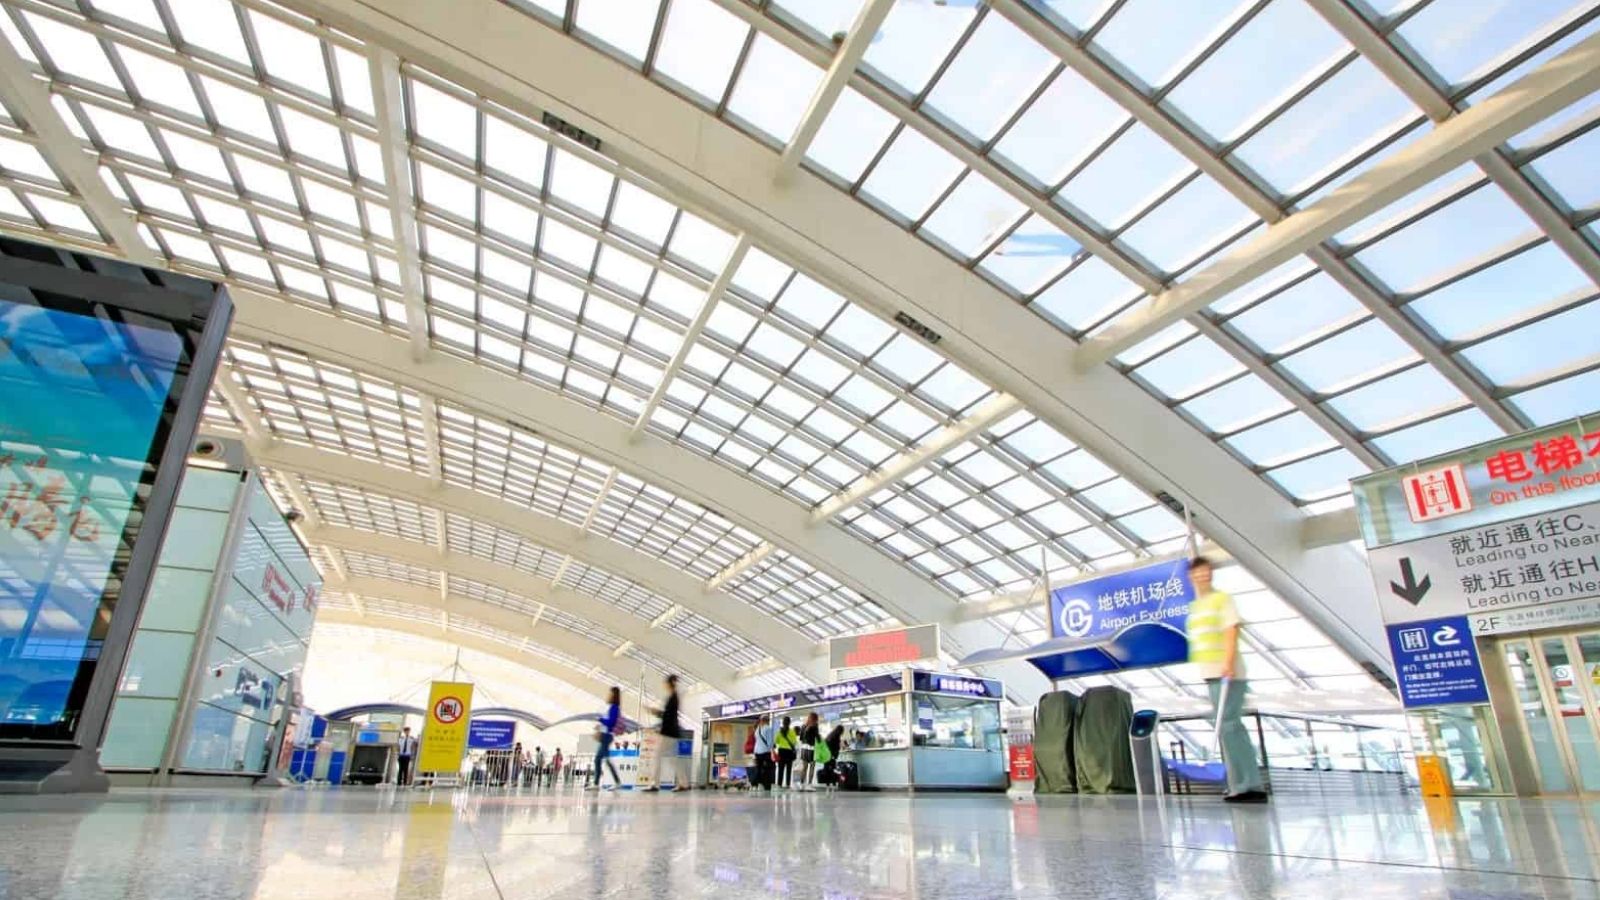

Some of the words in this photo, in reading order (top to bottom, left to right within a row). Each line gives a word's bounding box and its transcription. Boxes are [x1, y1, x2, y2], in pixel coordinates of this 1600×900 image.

[1490, 489, 1518, 505] On
[1522, 481, 1556, 498] this
[1455, 546, 1527, 568] Leading
[1530, 542, 1549, 554] to
[1098, 578, 1184, 611] 地铁机场线
[1467, 590, 1541, 609] Leading
[1544, 586, 1563, 598] to
[1569, 579, 1600, 594] Ne
[1100, 613, 1136, 630] Airport
[1139, 604, 1189, 623] Express
[1476, 616, 1500, 632] 2F
